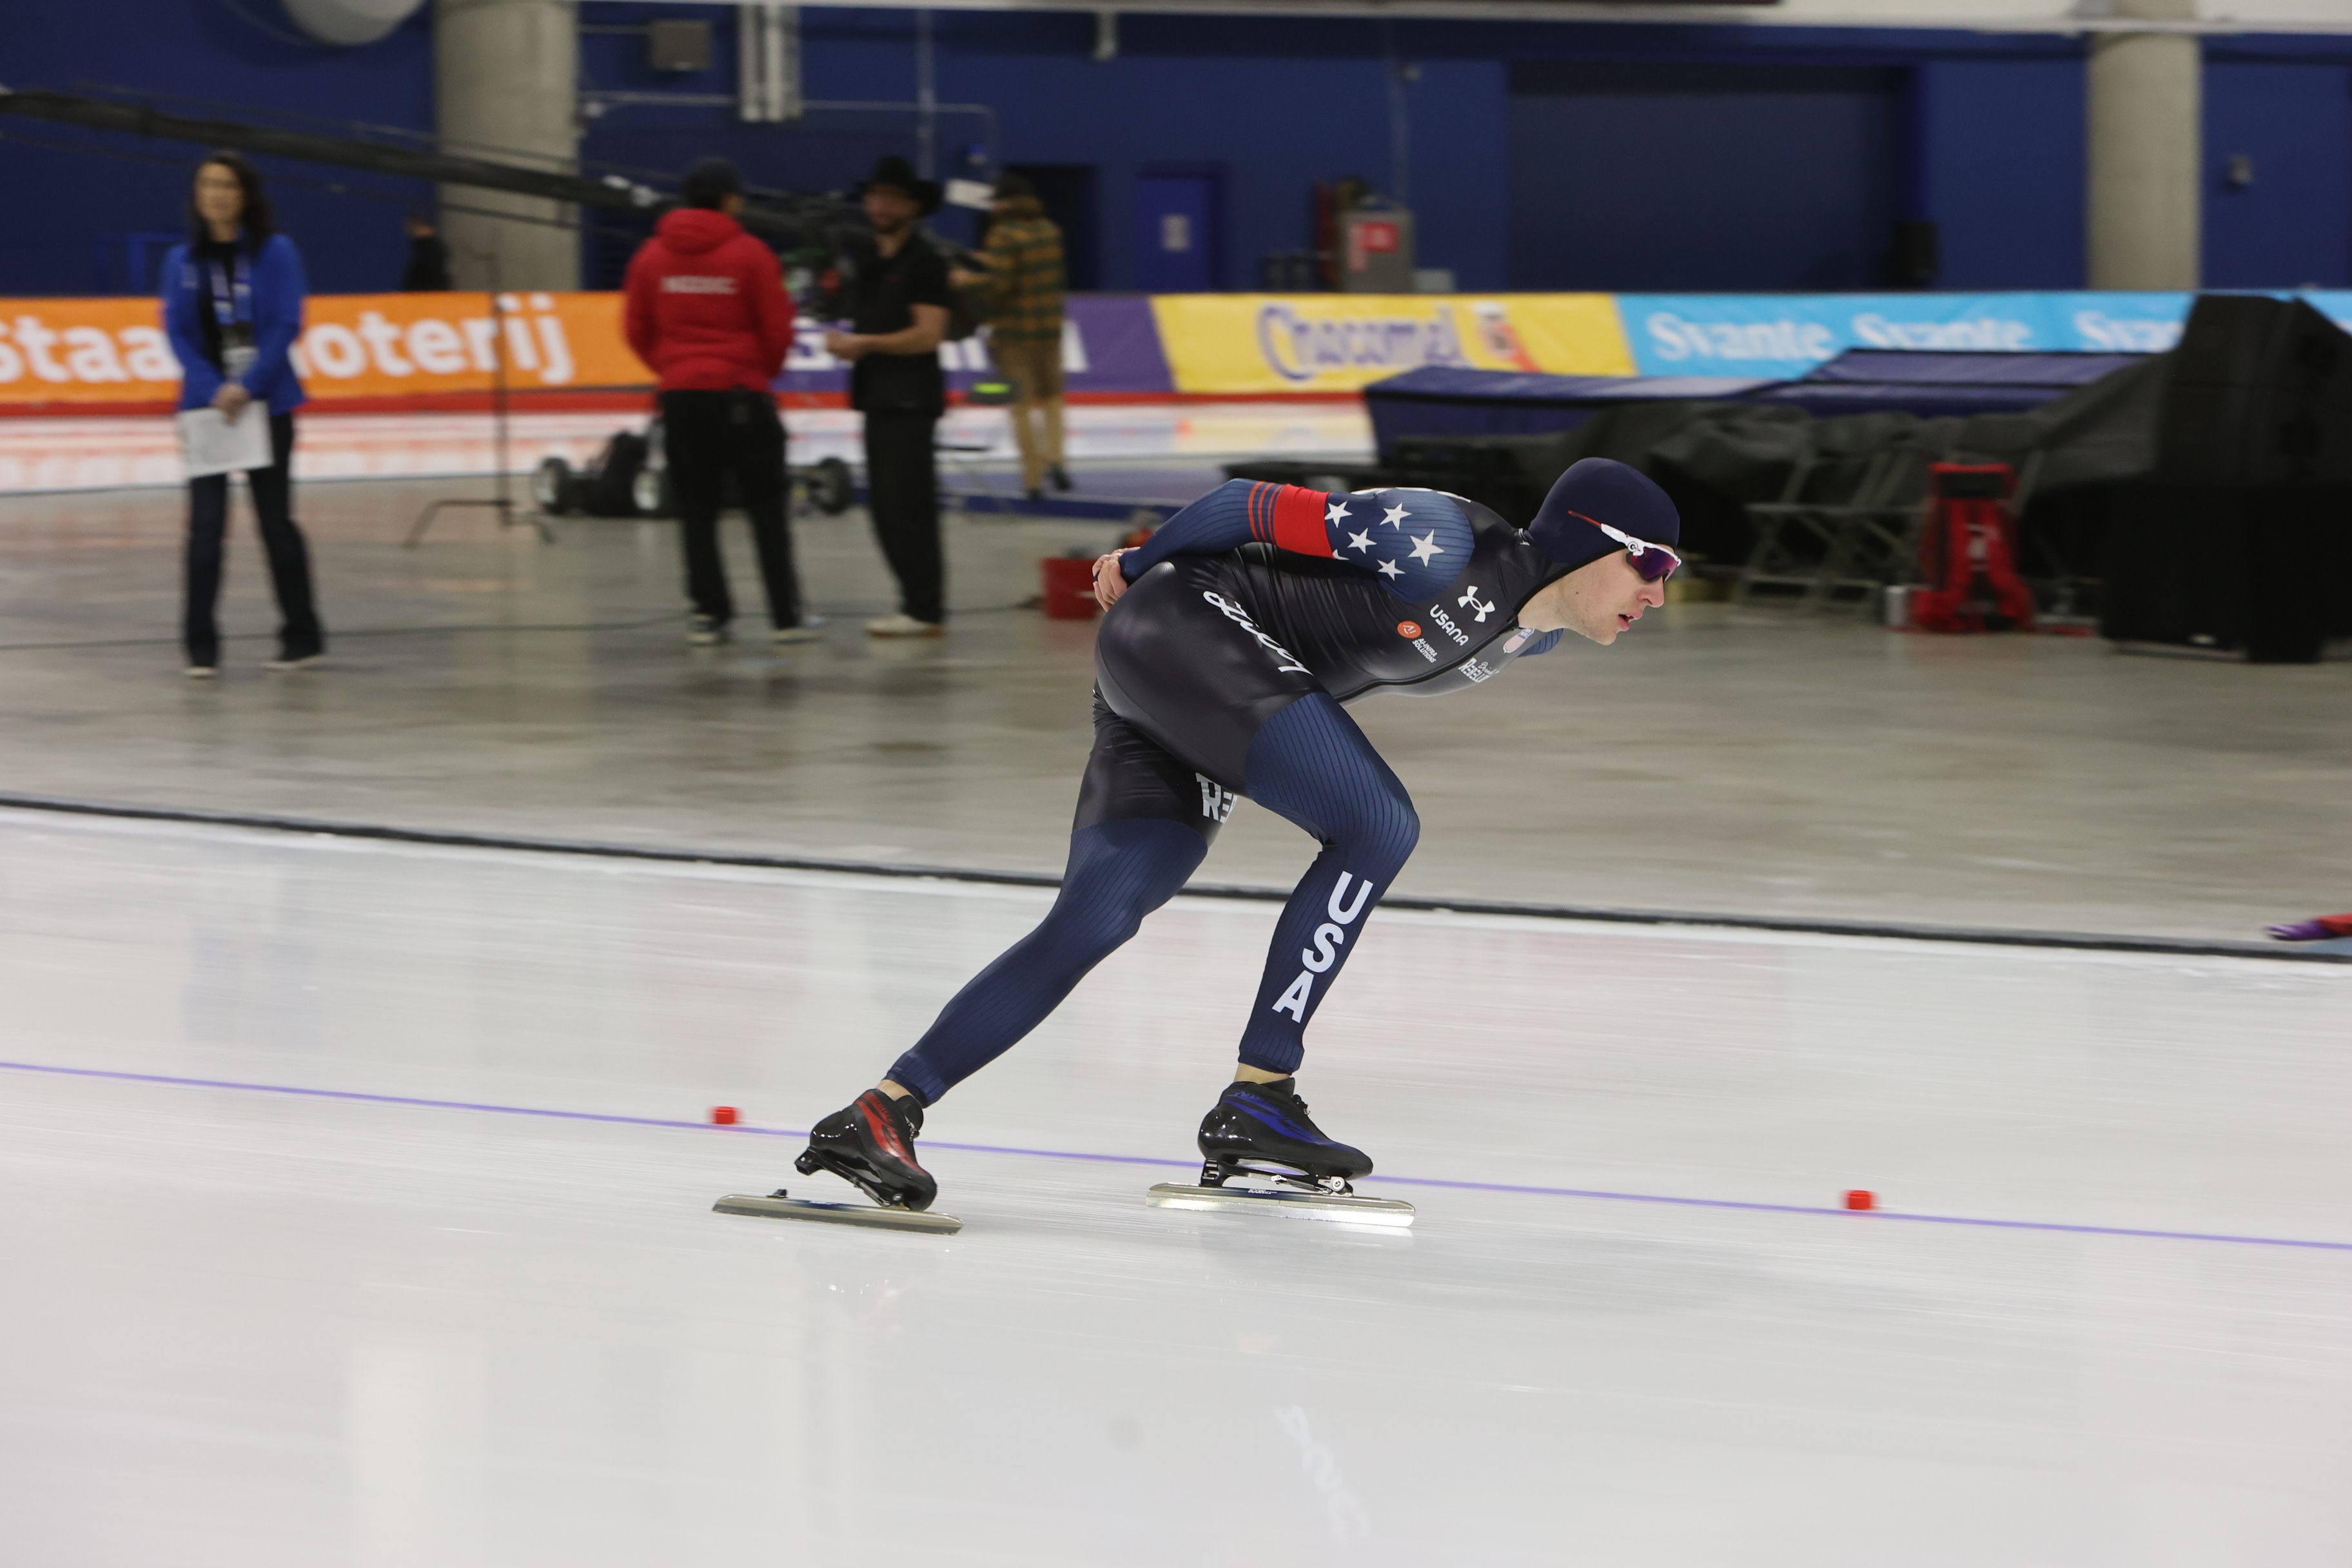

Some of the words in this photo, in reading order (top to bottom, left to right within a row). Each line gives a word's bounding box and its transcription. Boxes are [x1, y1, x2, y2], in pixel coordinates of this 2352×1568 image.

[0, 294, 573, 384] Staaoterij
[1646, 312, 1838, 361] Svante
[2074, 311, 2186, 353] Sva
[1429, 603, 1469, 647] USANA
[1412, 640, 1437, 663] SOLUTIONS
[1195, 772, 1238, 824] RE
[1271, 870, 1374, 1023] USA
